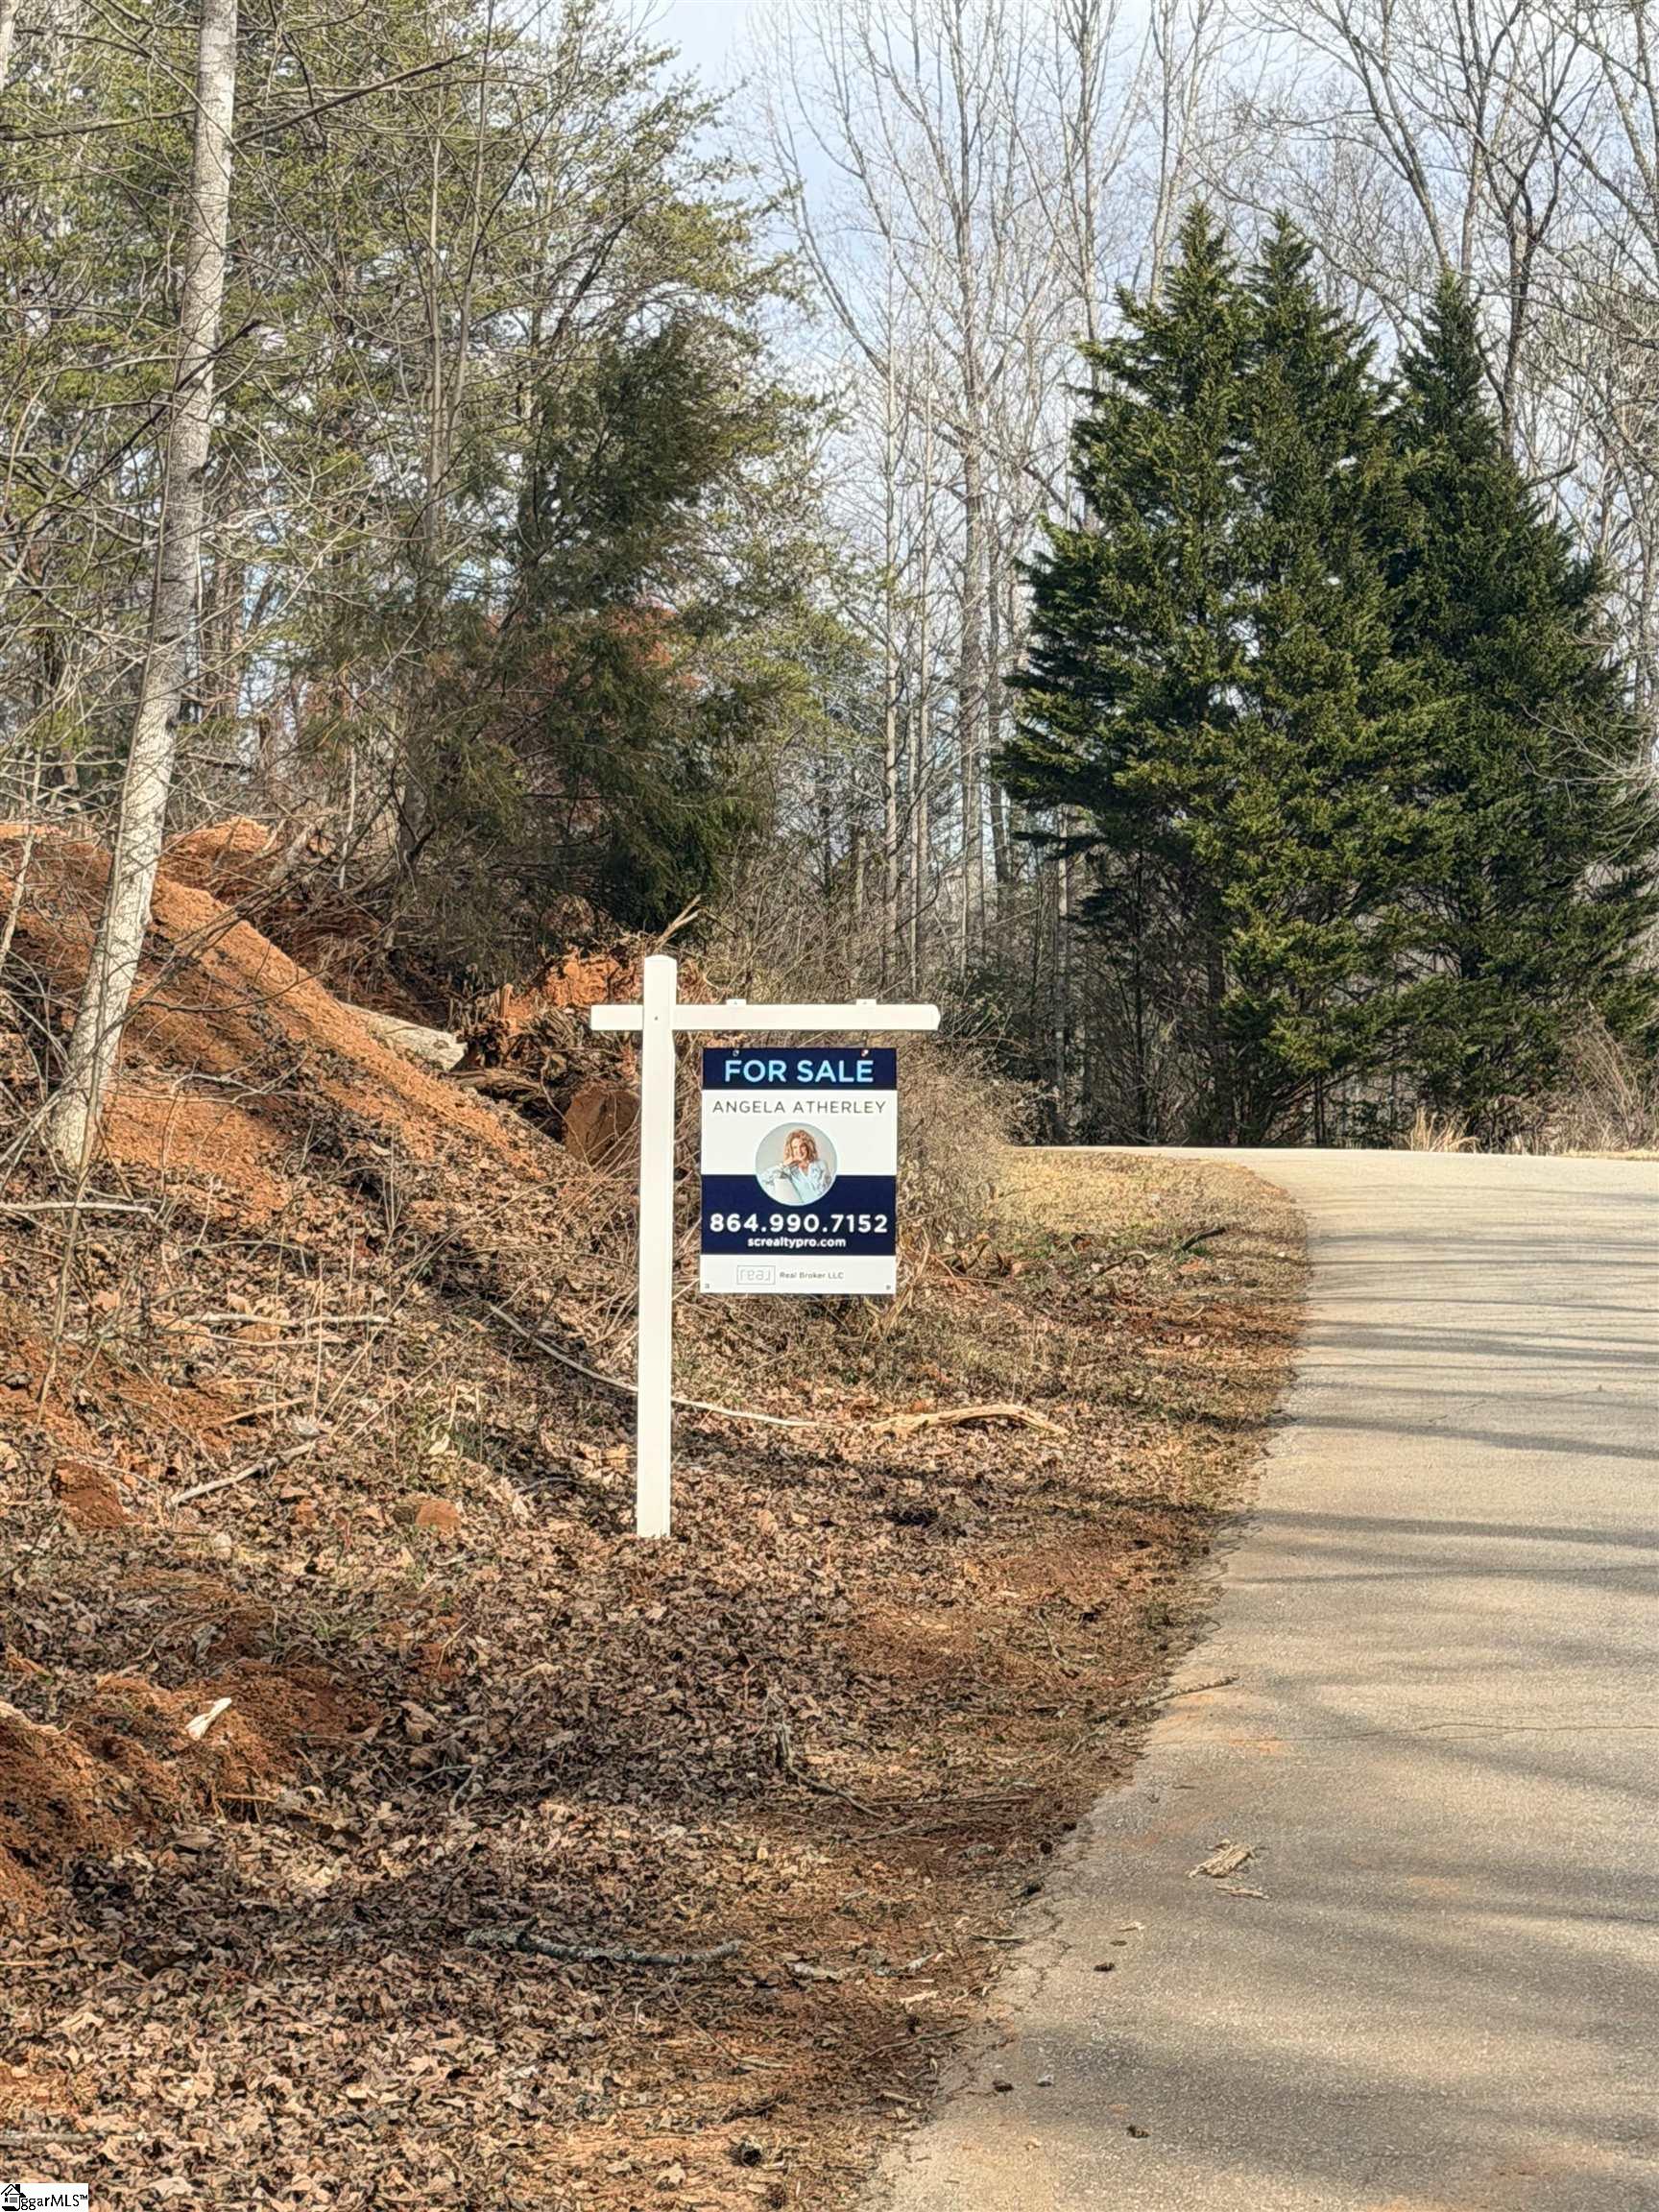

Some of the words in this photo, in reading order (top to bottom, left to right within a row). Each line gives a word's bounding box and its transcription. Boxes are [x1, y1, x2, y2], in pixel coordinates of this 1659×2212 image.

[725, 1060, 786, 1082] FOR
[797, 1060, 874, 1083] SALE
[712, 1100, 785, 1114] ANGELA
[792, 1100, 886, 1114] ATHERLEY
[709, 1213, 888, 1234] 864.990.7152
[747, 1236, 846, 1249] screaltypro.com
[779, 1271, 797, 1280] Real
[799, 1271, 826, 1280] Broker
[828, 1271, 845, 1280] LLC
